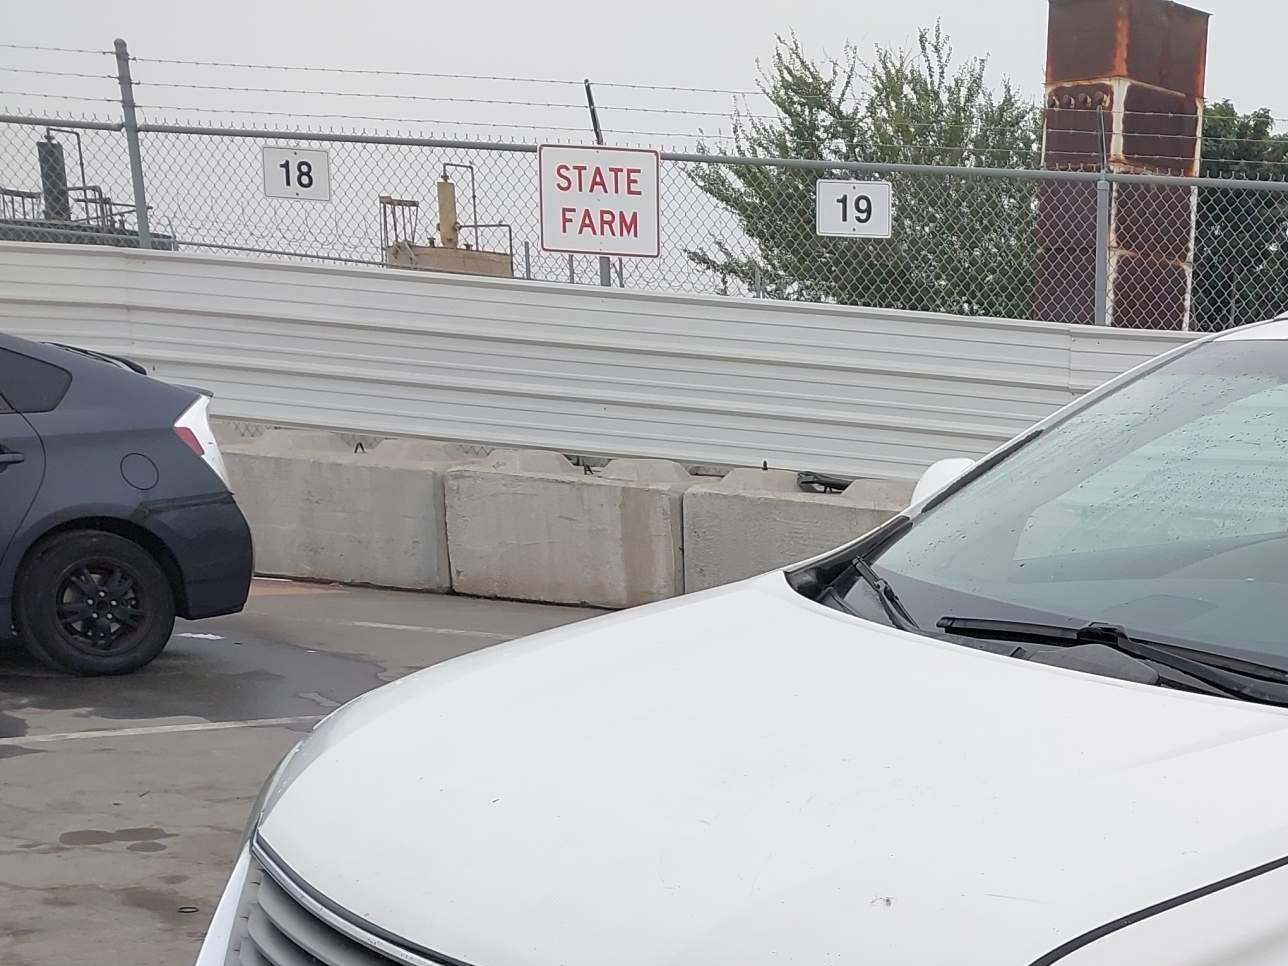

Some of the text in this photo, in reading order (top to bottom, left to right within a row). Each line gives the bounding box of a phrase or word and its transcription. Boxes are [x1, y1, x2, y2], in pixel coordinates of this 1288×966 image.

[279, 160, 313, 188] 18
[556, 164, 642, 195] STATE
[561, 207, 638, 238] FARM
[836, 194, 872, 223] 19
